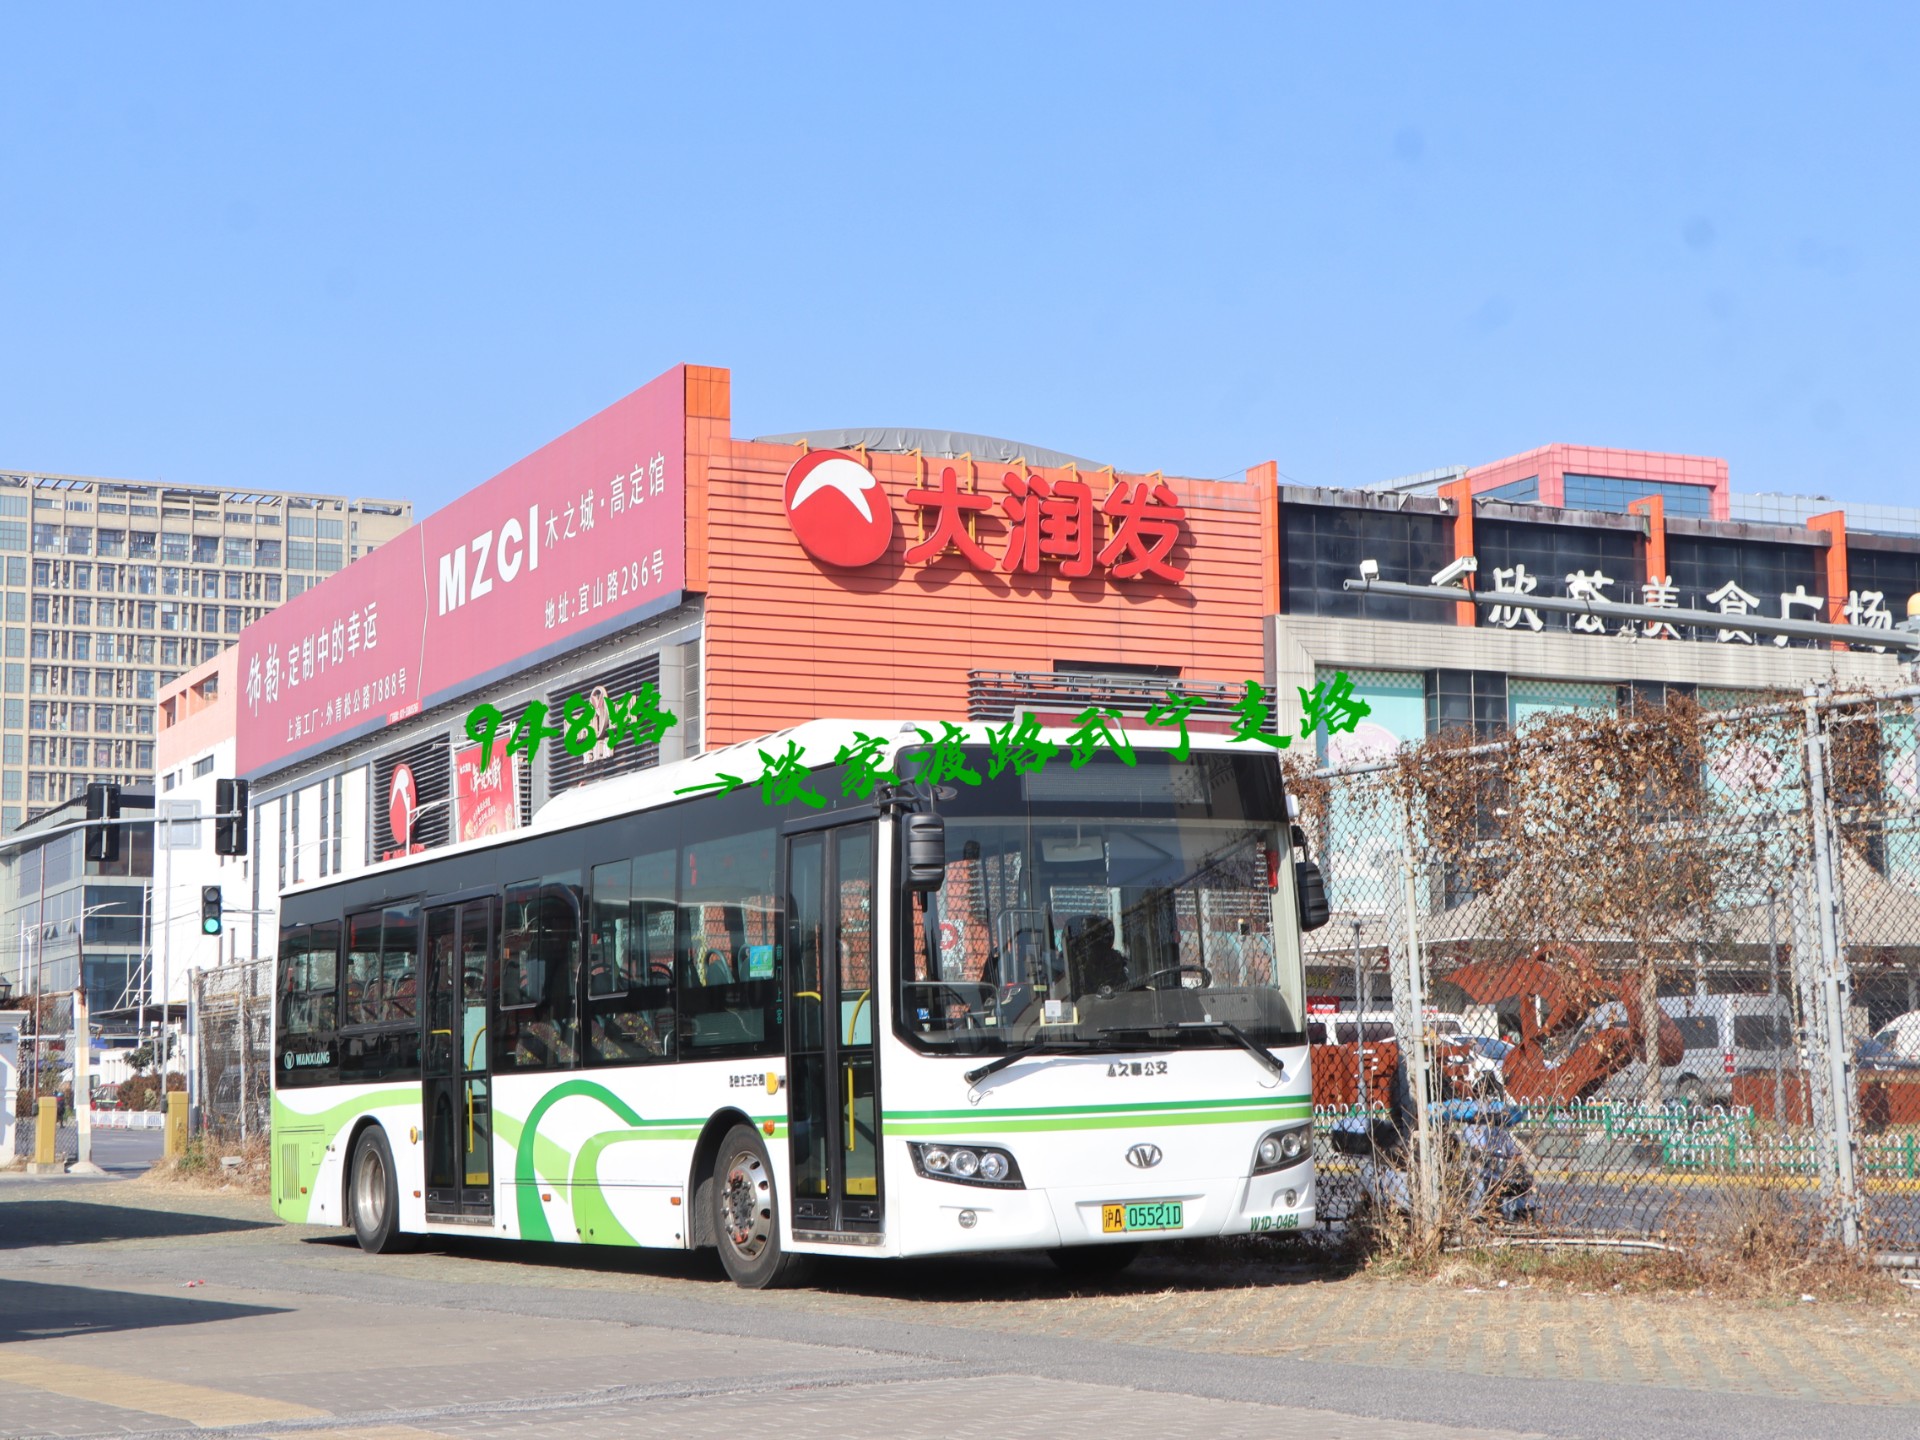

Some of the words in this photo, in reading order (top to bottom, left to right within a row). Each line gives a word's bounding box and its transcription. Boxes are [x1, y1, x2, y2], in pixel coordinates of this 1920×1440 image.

[438, 503, 539, 617] MZCI
[544, 451, 665, 550] 木之城·高定馆
[903, 466, 1186, 583] 大润发
[544, 548, 665, 629] 地址:宜山路286号
[286, 667, 407, 743] 上海工厂:外青松公路7888号
[295, 1051, 330, 1066] WANXIANG
[1118, 1060, 1168, 1077] 久事公交
[1129, 1205, 1181, 1227] 05521D
[1250, 1213, 1299, 1231] W1D-0464
